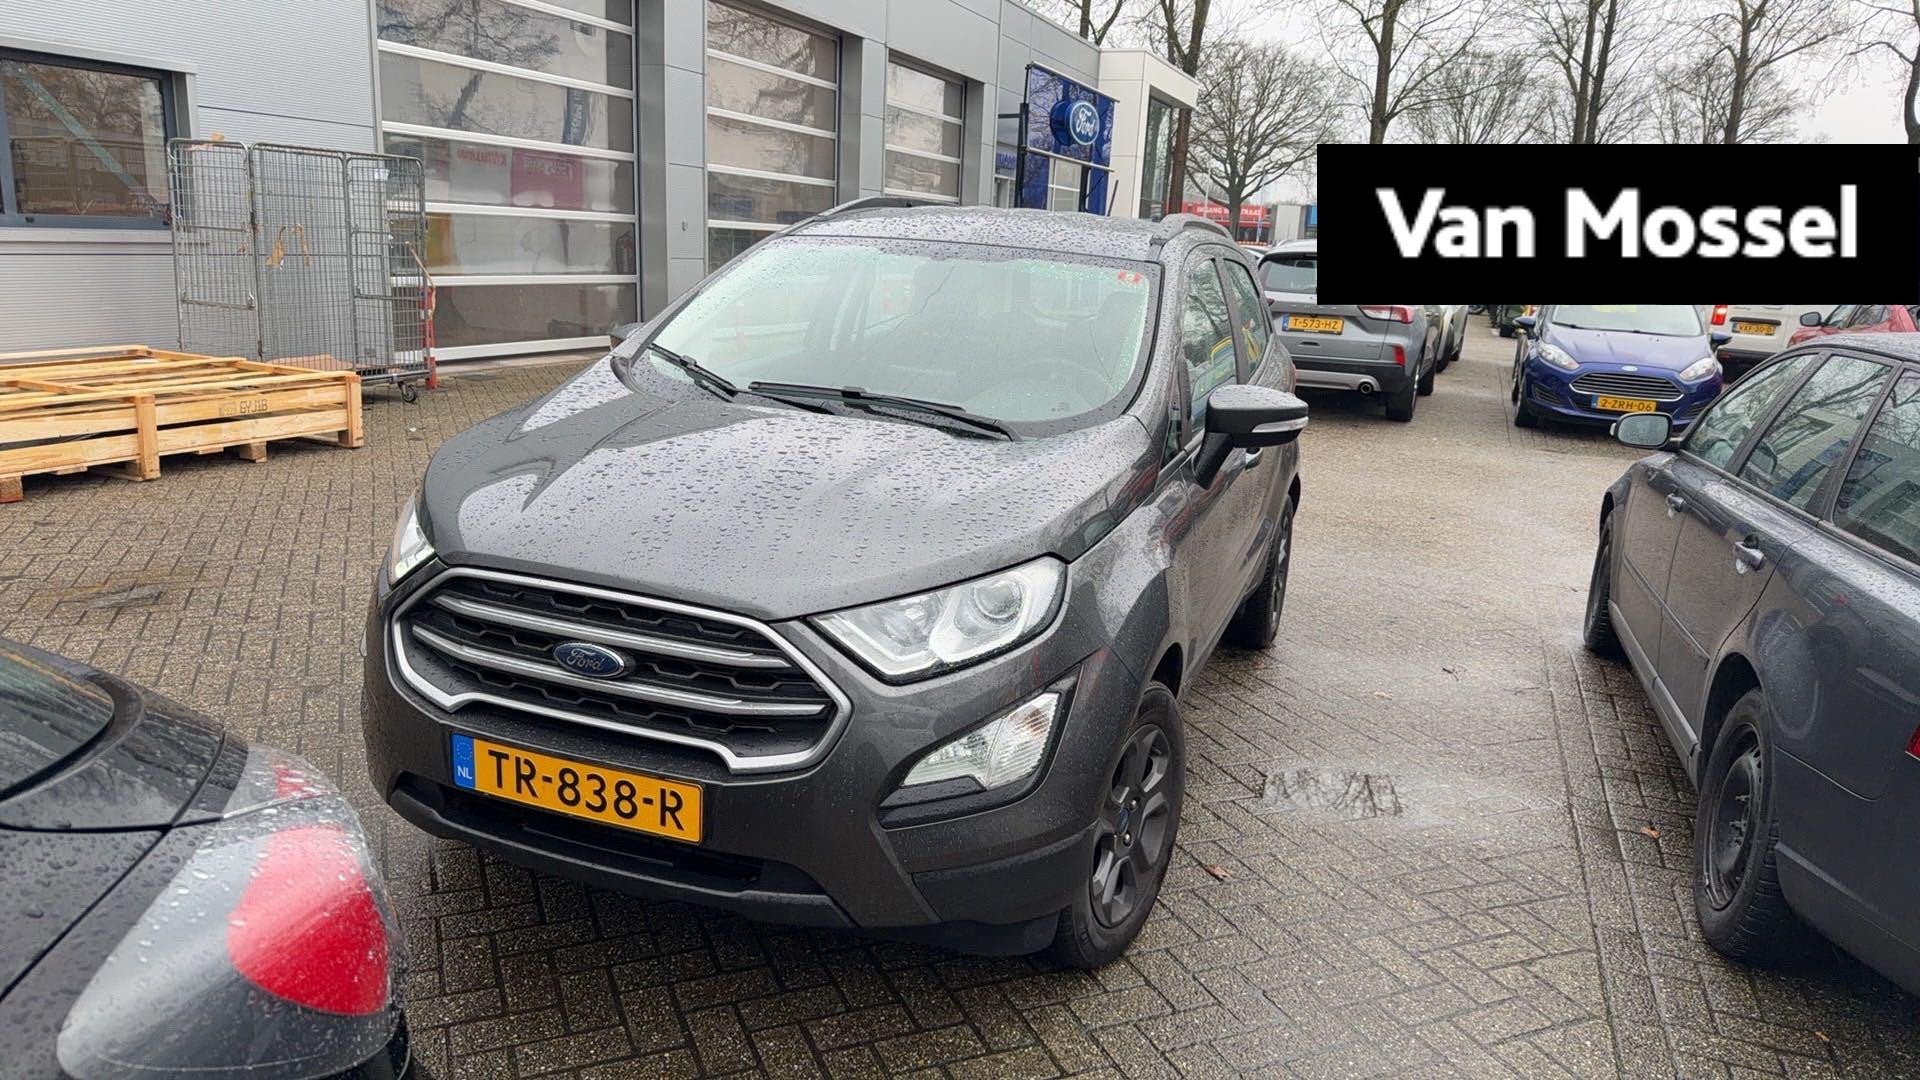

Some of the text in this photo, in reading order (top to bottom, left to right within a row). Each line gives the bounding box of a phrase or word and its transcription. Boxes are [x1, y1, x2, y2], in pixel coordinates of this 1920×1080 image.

[1075, 107, 1096, 137] Ford
[1293, 318, 1338, 330] T-573-HZ
[1601, 398, 1653, 412] 2-ZRH-06
[565, 647, 605, 671] Ford
[457, 749, 685, 832] NL TR-838-R
